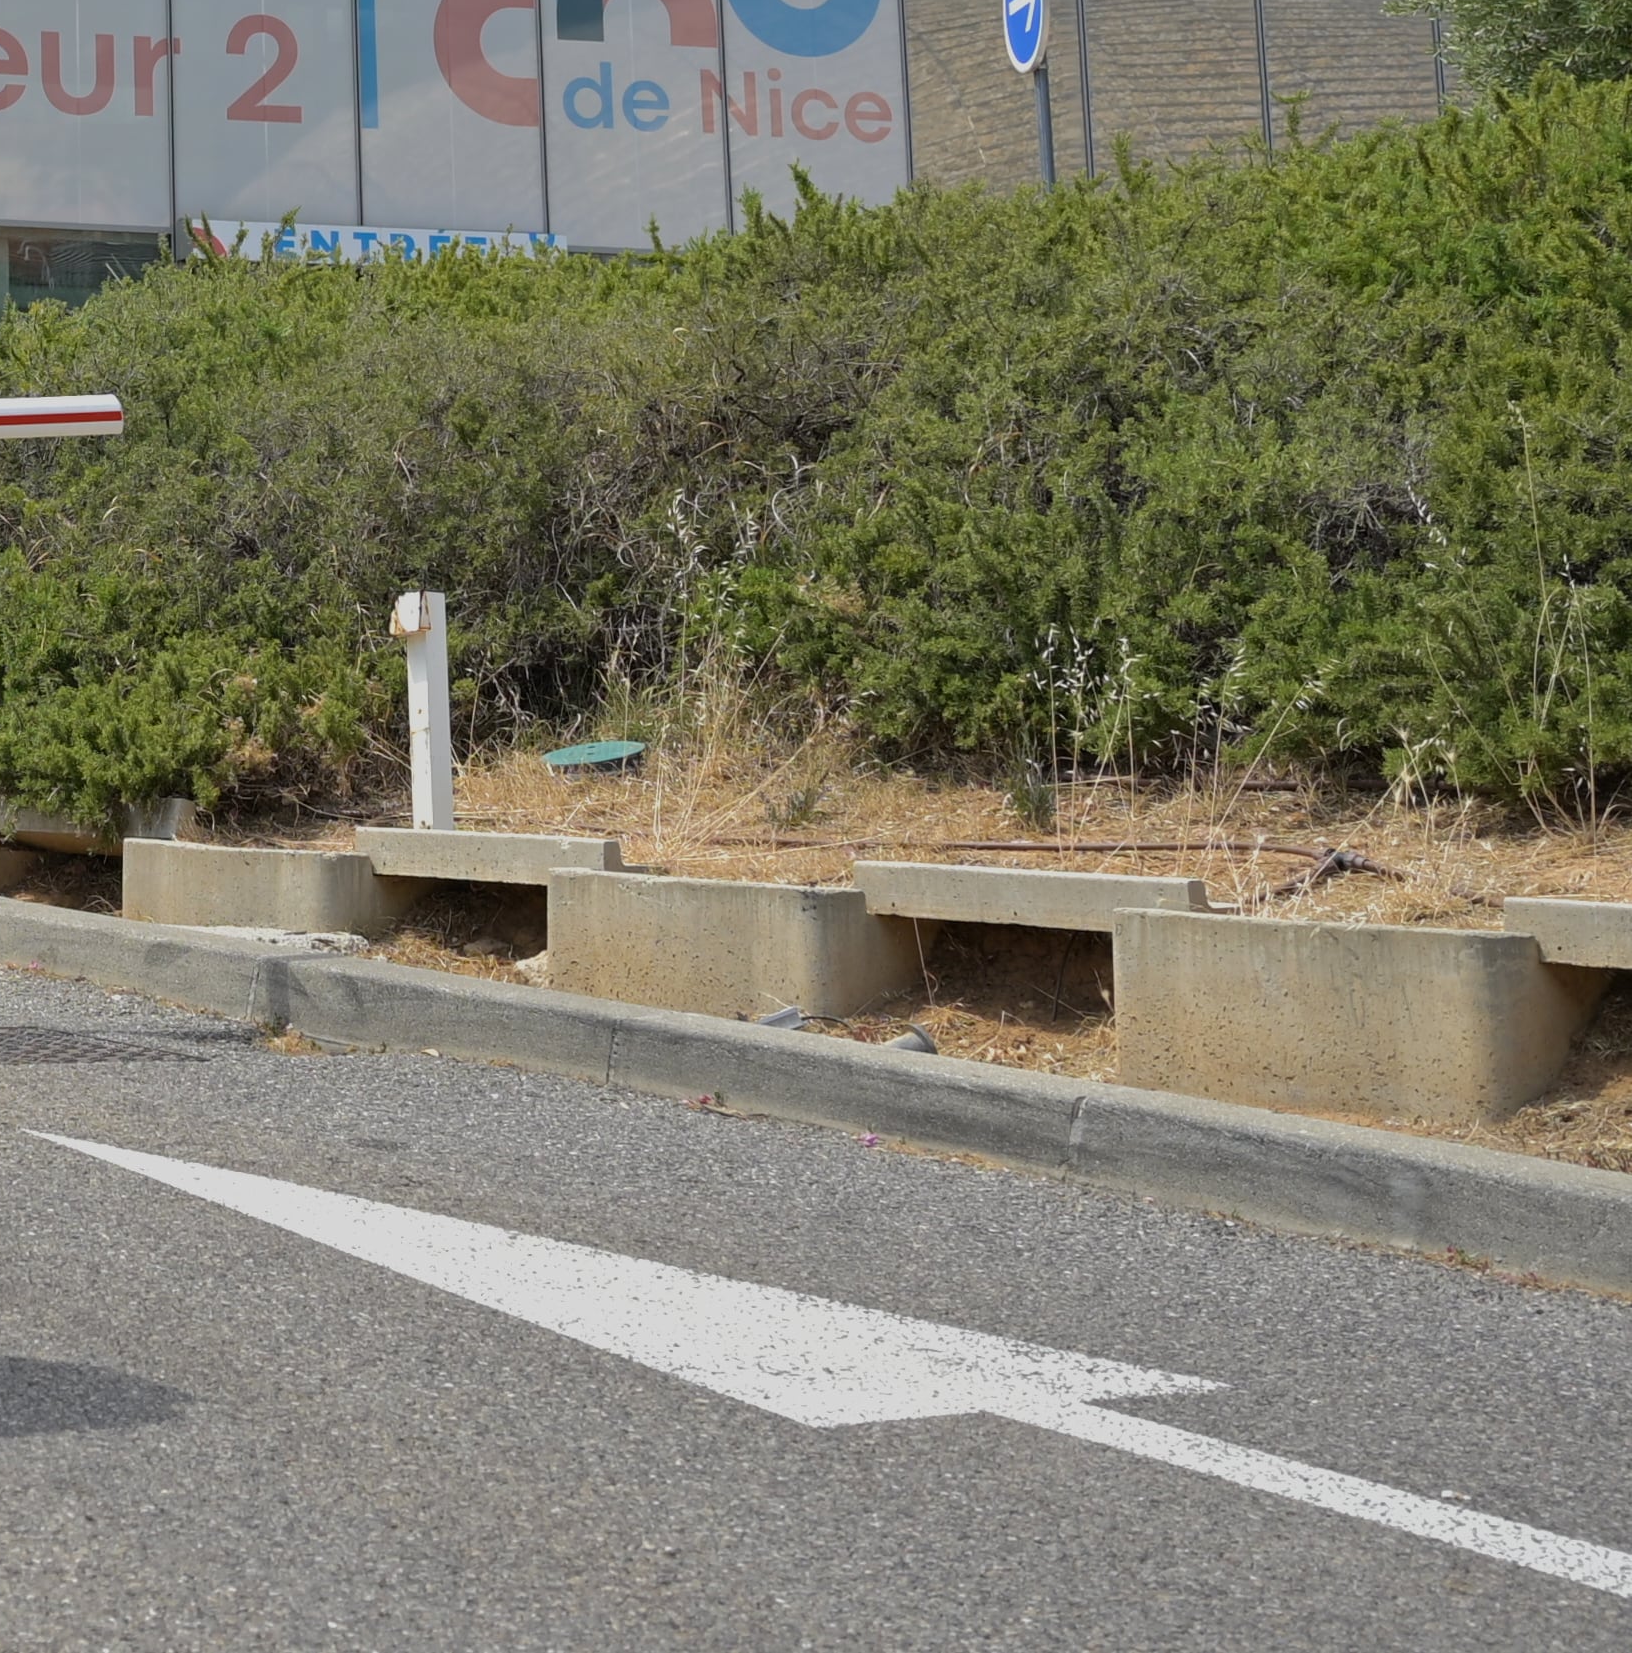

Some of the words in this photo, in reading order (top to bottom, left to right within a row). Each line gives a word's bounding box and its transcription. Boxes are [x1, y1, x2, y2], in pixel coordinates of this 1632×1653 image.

[225, 13, 303, 125] 2
[562, 61, 670, 132] de
[700, 67, 893, 144] Nice
